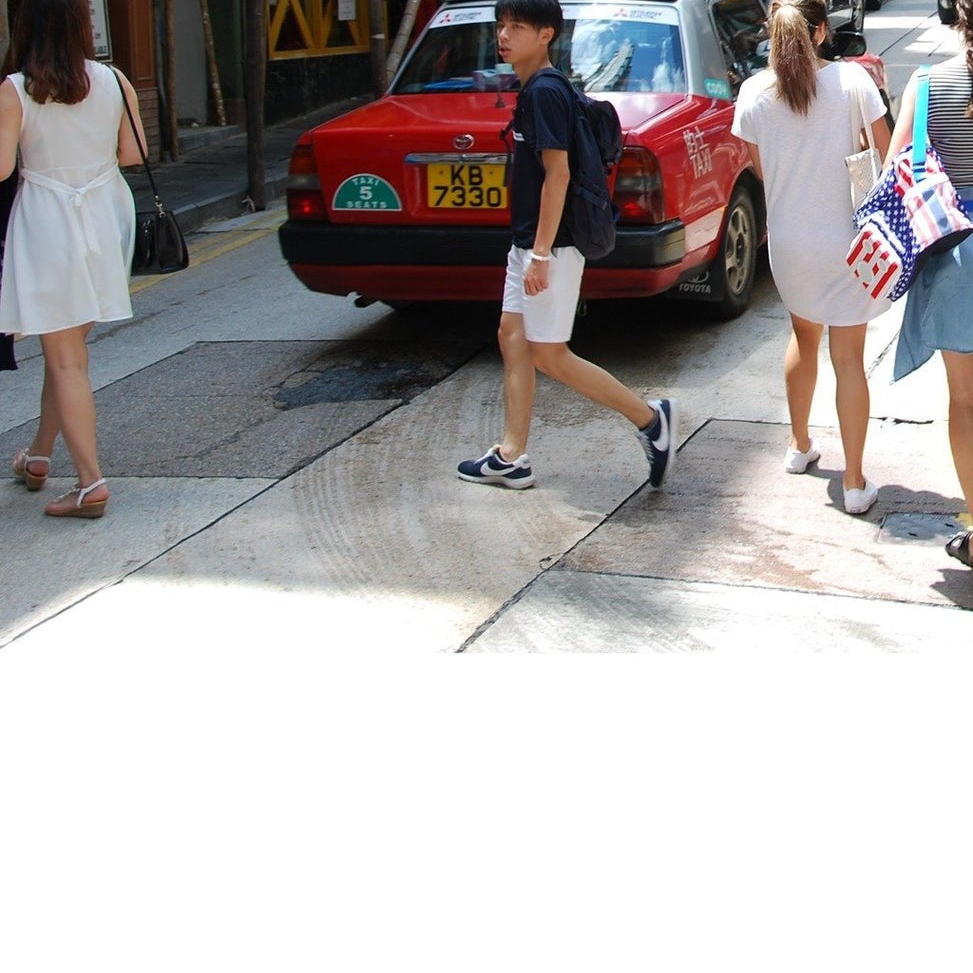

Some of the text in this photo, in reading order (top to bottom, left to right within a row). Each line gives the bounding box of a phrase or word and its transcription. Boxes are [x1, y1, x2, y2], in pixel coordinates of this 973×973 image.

[683, 126, 710, 157] 的士
[689, 146, 712, 179] TAXI
[352, 177, 379, 186] TAXI
[451, 165, 483, 186] KB
[360, 186, 373, 199] 5
[434, 186, 501, 208] 7330
[346, 201, 387, 209] SEATS
[679, 283, 711, 293] TOYOTA
